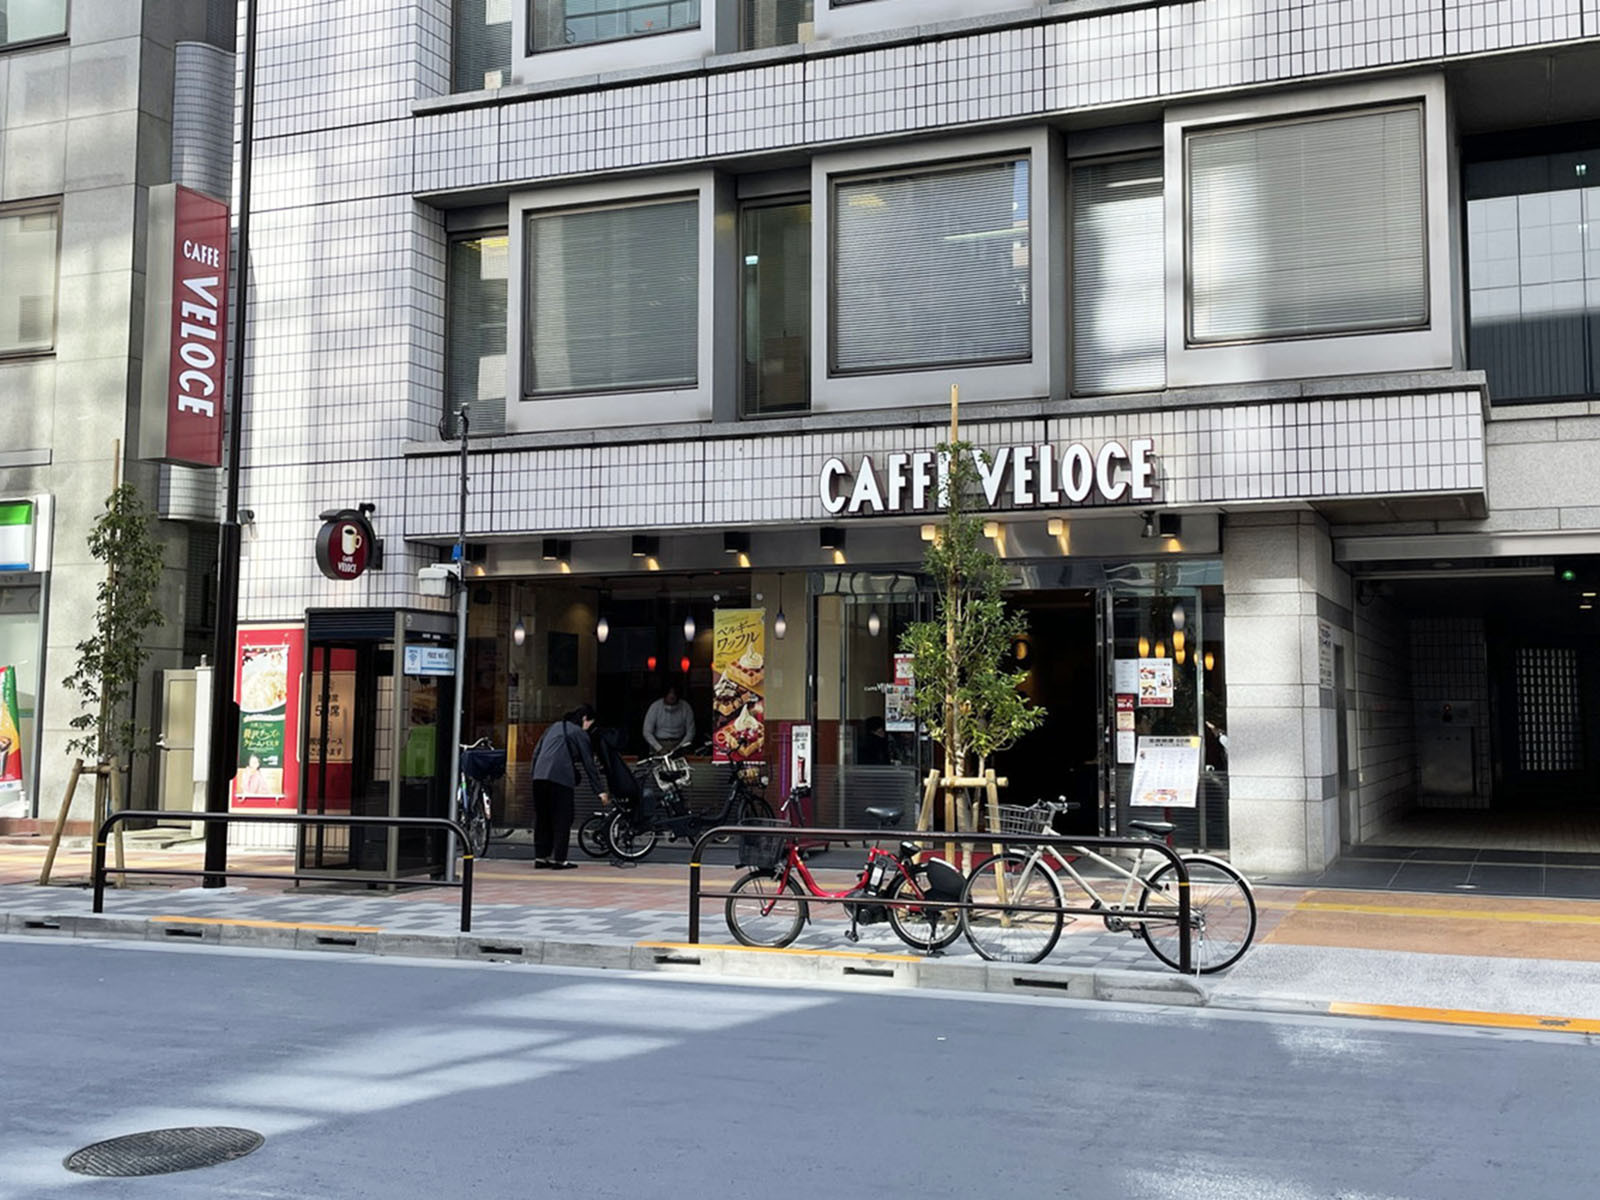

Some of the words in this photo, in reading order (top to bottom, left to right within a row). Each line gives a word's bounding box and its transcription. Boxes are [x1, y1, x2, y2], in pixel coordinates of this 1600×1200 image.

[183, 240, 219, 268] CAFFE
[178, 277, 218, 418] VELOCE
[972, 439, 1153, 507] VELOCE
[716, 632, 760, 651] ワッフル
